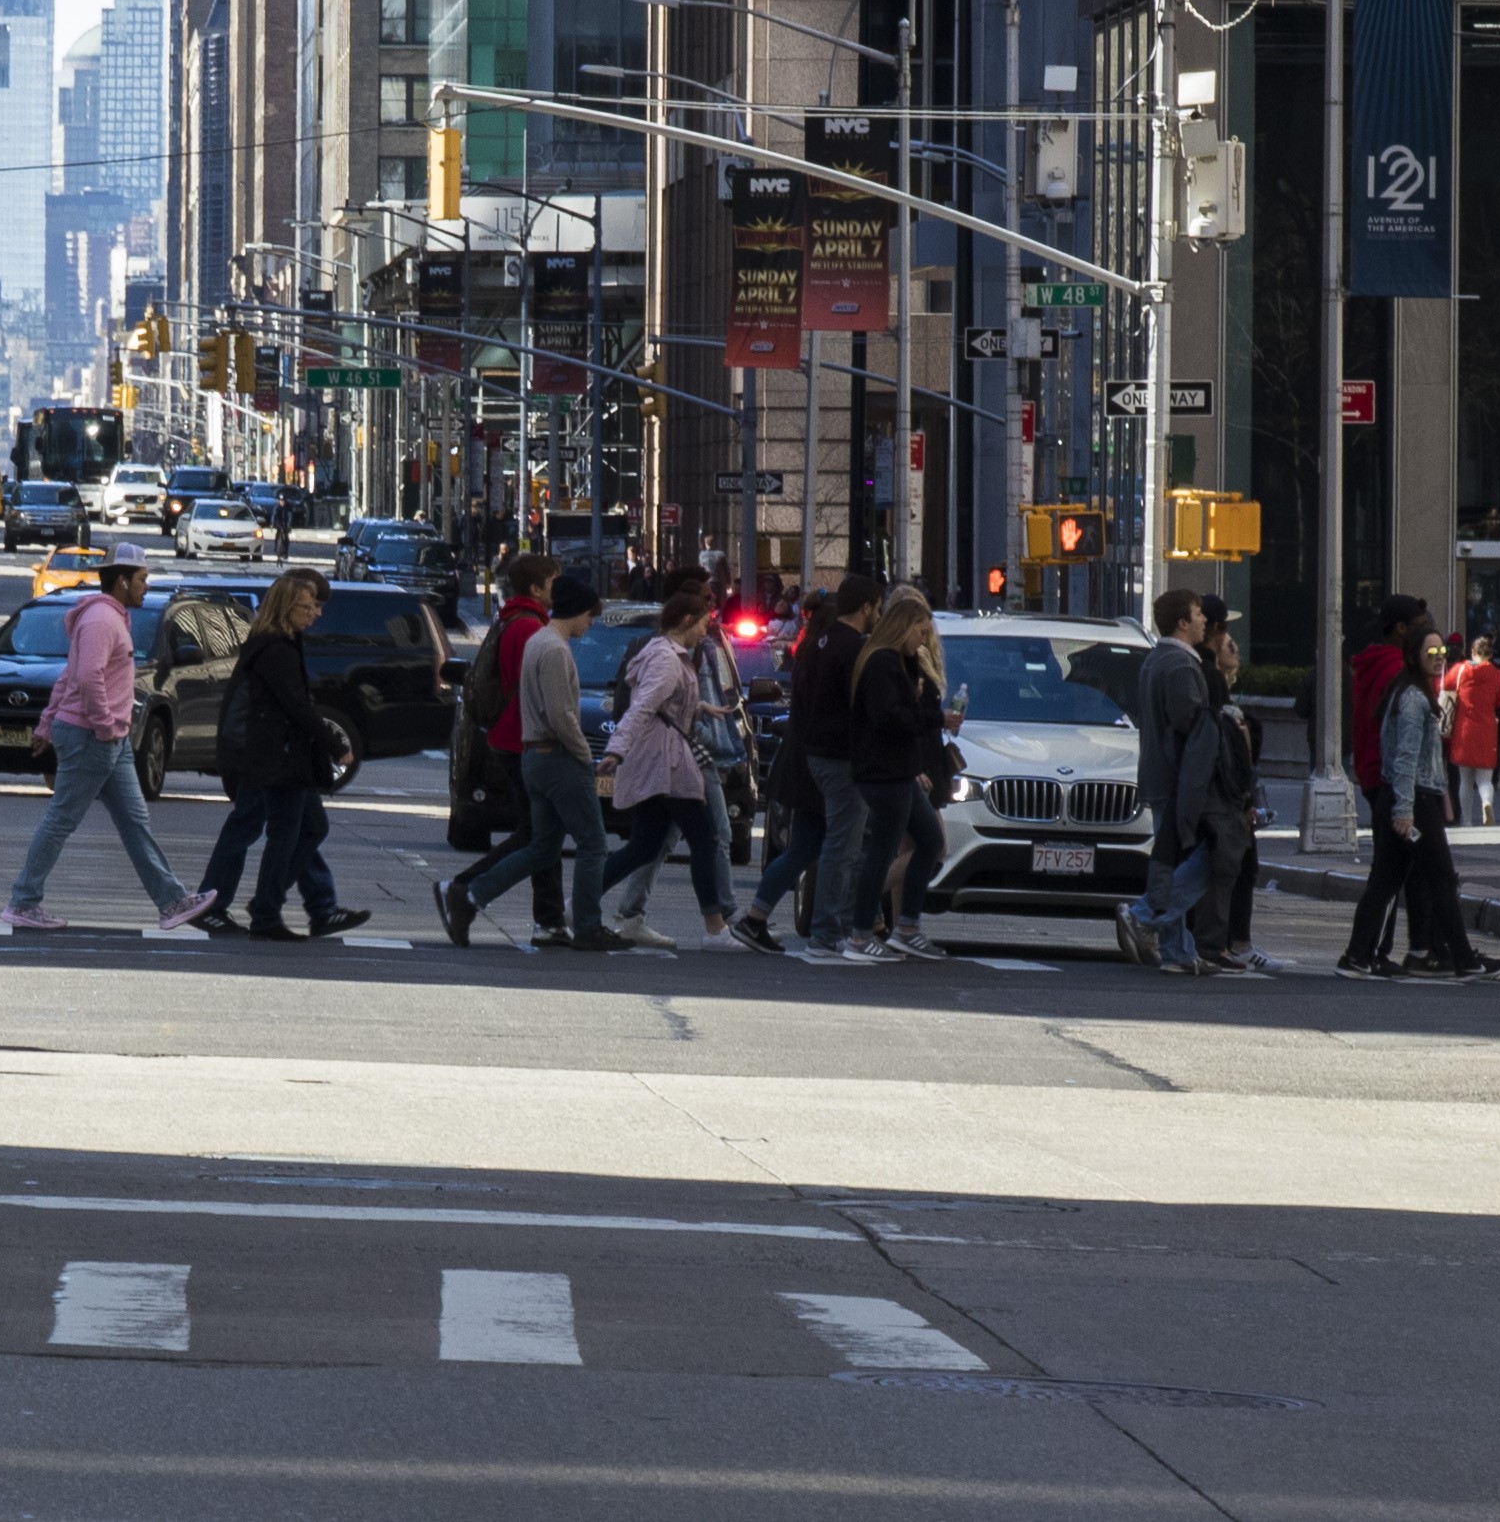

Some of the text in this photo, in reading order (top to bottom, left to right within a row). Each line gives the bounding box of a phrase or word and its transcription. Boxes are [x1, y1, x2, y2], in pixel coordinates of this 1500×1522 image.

[825, 118, 870, 133] NYC
[1367, 144, 1436, 210] 1221
[750, 178, 790, 193] NYC
[811, 220, 882, 238] SUNDAY
[1388, 225, 1435, 233] AMERICAS
[812, 240, 882, 258] APRIL 7
[547, 258, 575, 269] NYC
[429, 267, 451, 276] NYC
[738, 269, 797, 284] SUNDAY
[737, 286, 797, 303] APRIL 7
[1040, 287, 1100, 303] W 48 ST
[981, 338, 1007, 350] ONE
[328, 373, 381, 384] W 46 St
[1343, 385, 1367, 393] ANDING
[1122, 392, 1149, 405] ONE
[1036, 850, 1092, 868] 7FV 257
